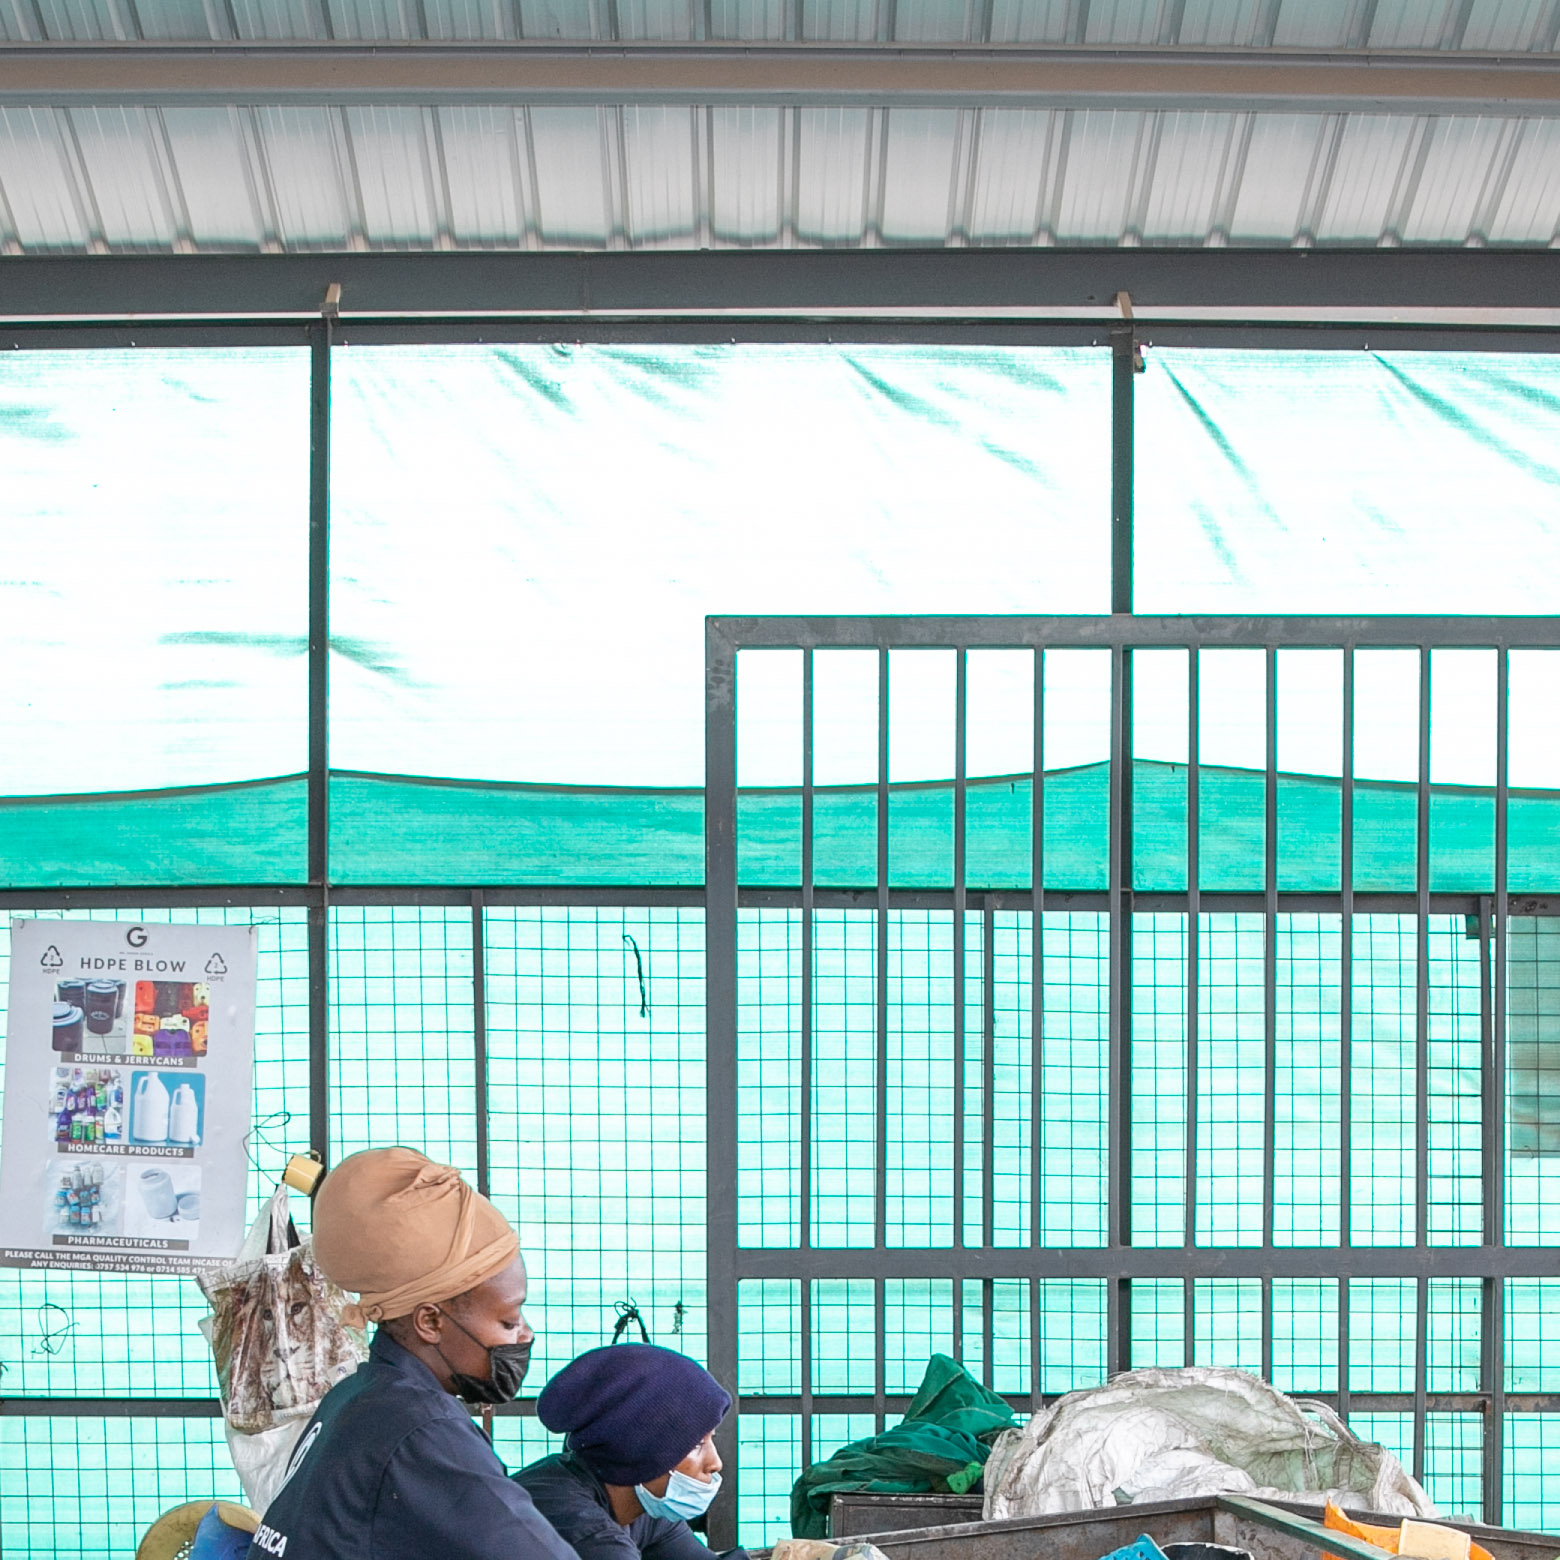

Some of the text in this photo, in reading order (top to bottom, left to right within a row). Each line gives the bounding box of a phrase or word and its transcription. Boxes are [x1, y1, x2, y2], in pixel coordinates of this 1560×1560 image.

[126, 926, 148, 948] G
[80, 957, 186, 973] HDPE BLOW
[74, 1053, 184, 1066] DRUMS & JERRYCANS
[68, 1143, 184, 1156] HOMECARE PRODUCTS
[67, 1236, 169, 1248] PHARMACEUTICALS
[4, 1250, 33, 1259] PLEASE
[34, 1251, 54, 1260] CALL
[55, 1252, 71, 1260] THE
[72, 1253, 91, 1261] MGA
[92, 1254, 128, 1263] QUALITY
[128, 1256, 167, 1265] CONTROL
[168, 1258, 191, 1266] TEAM
[192, 1258, 220, 1267] INCASE
[30, 1260, 48, 1268] ANY
[94, 1263, 113, 1271] 0757
[114, 1264, 130, 1272] 534
[131, 1264, 145, 1273] 976
[155, 1266, 175, 1274] 0714
